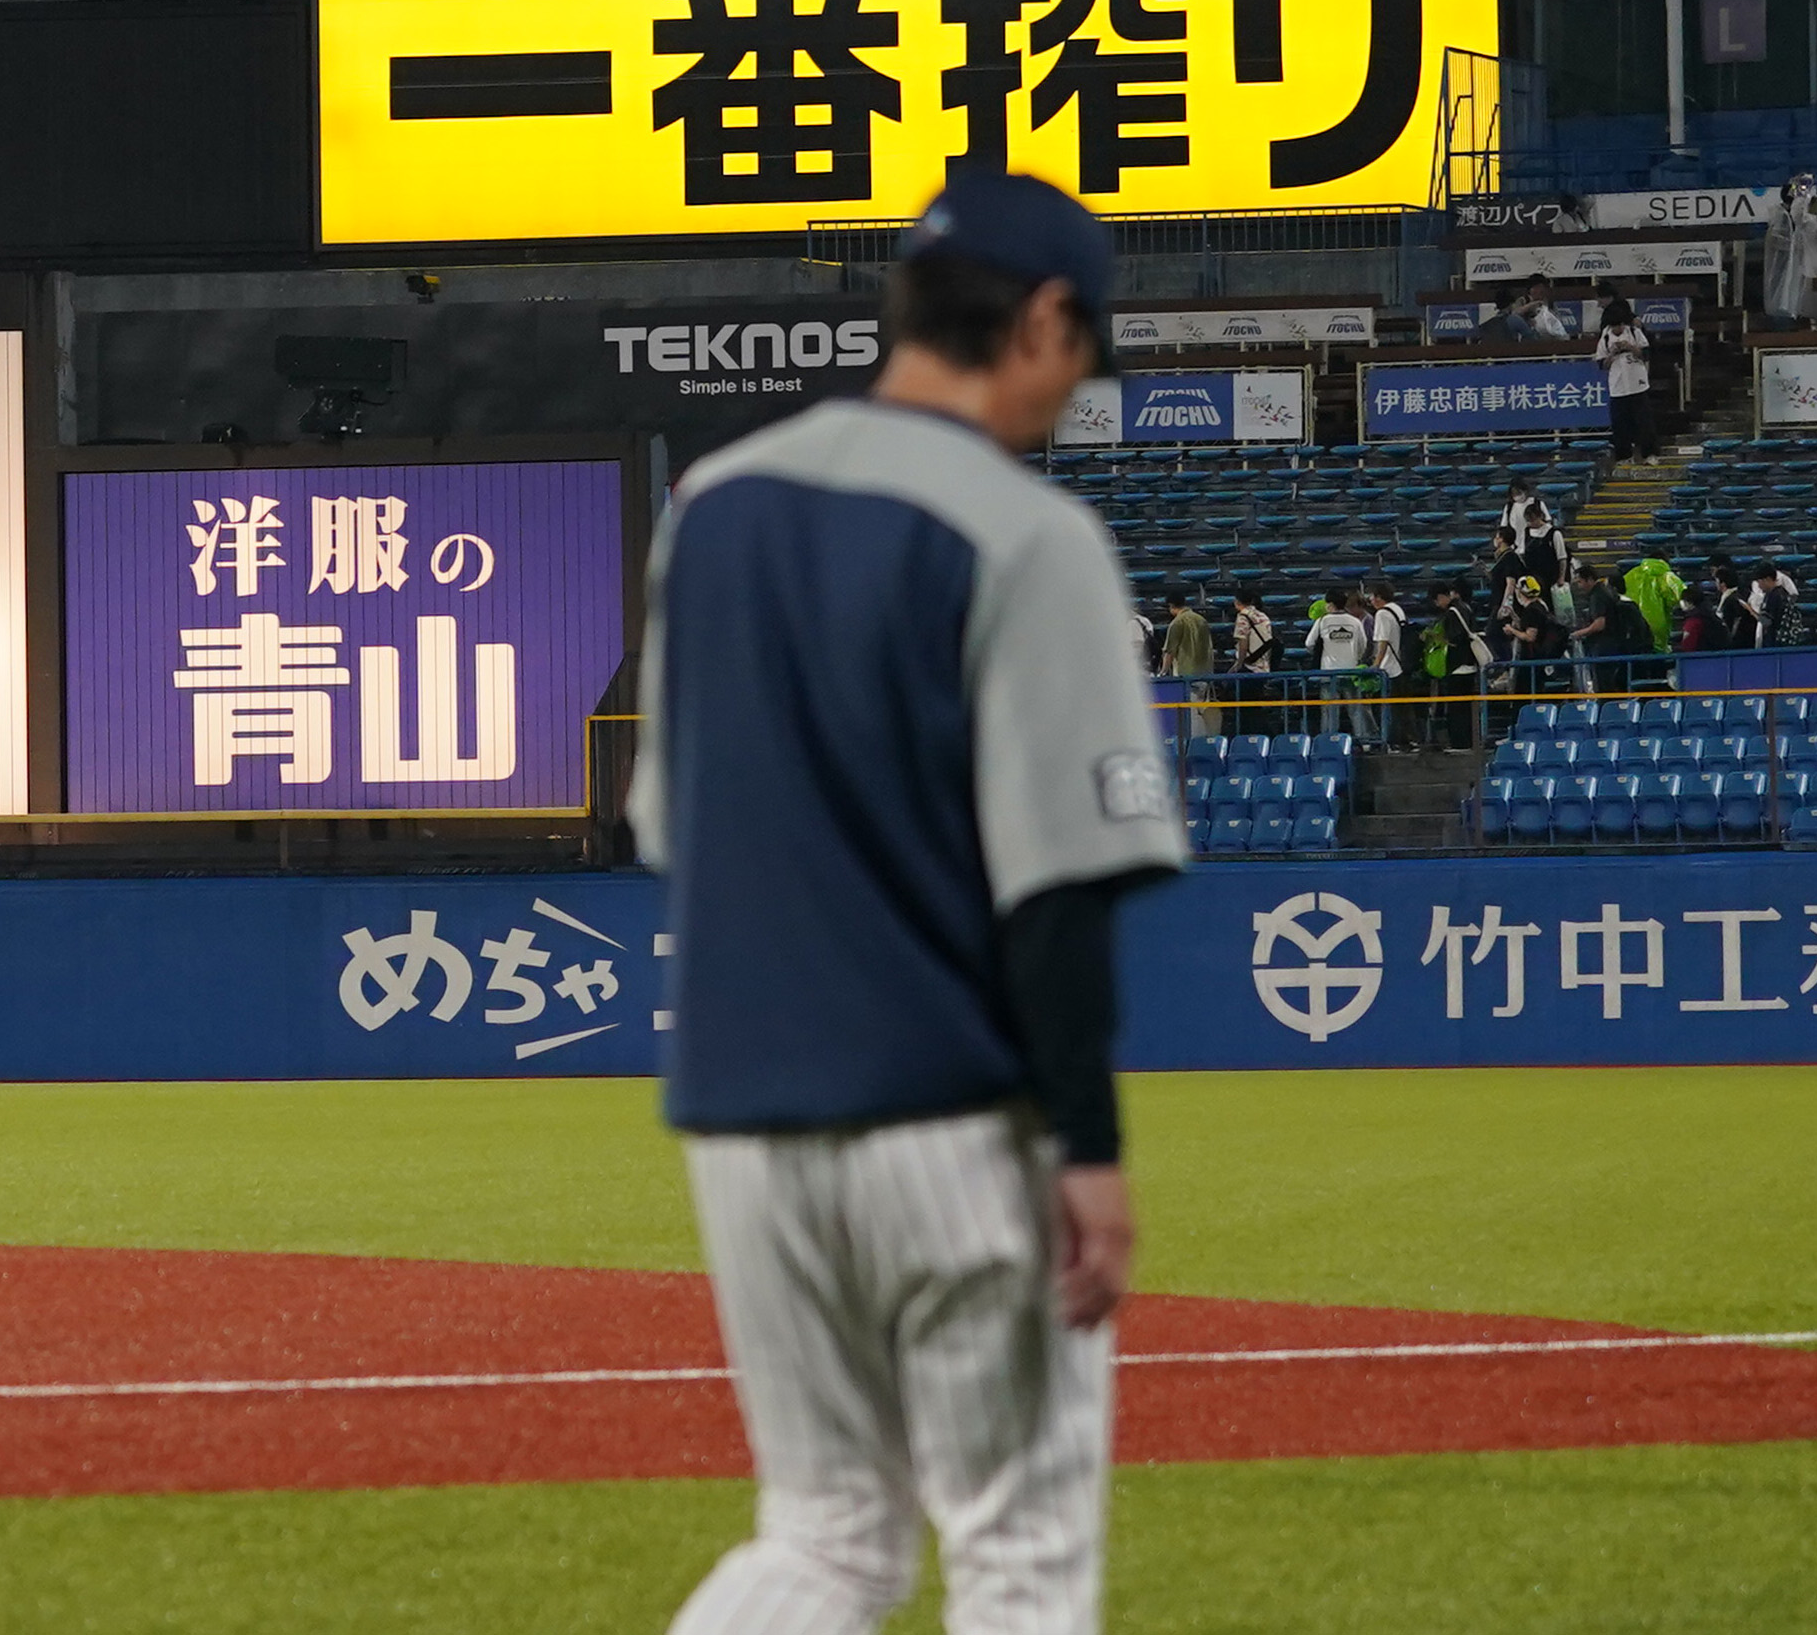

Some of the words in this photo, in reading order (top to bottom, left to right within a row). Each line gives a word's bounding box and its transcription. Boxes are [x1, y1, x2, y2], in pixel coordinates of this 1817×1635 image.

[1719, 8, 1746, 51] L
[1649, 194, 1755, 221] SEDIA
[604, 320, 879, 373] TEKNOS
[1120, 328, 1160, 339] ITOCHU
[1222, 325, 1263, 336] ITOCHU
[1326, 323, 1365, 334] ITOCHU
[680, 379, 737, 395] Simple
[742, 378, 756, 392] is
[762, 377, 802, 392] Best
[1375, 383, 1607, 415] 伊藤忠商事株式会社
[1135, 405, 1222, 427] ITOCHU
[186, 495, 495, 597] 洋服の
[174, 613, 517, 787] 青山
[339, 910, 676, 1031] めちゃ
